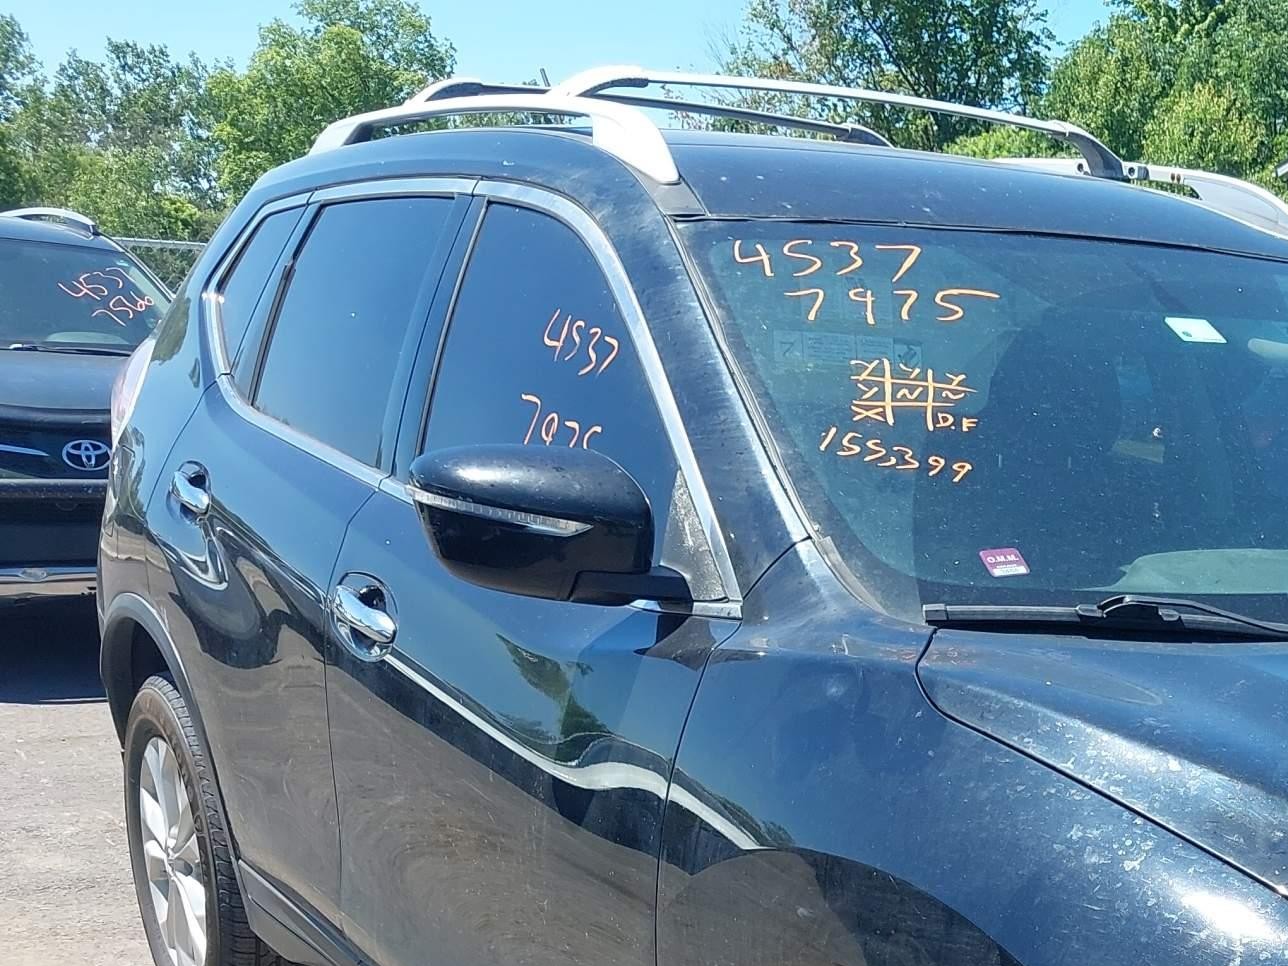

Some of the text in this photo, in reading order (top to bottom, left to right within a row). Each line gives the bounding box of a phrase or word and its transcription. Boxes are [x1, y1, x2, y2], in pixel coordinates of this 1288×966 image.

[733, 239, 922, 283] 4537
[784, 288, 1000, 325] 7975
[543, 308, 619, 376] 4537
